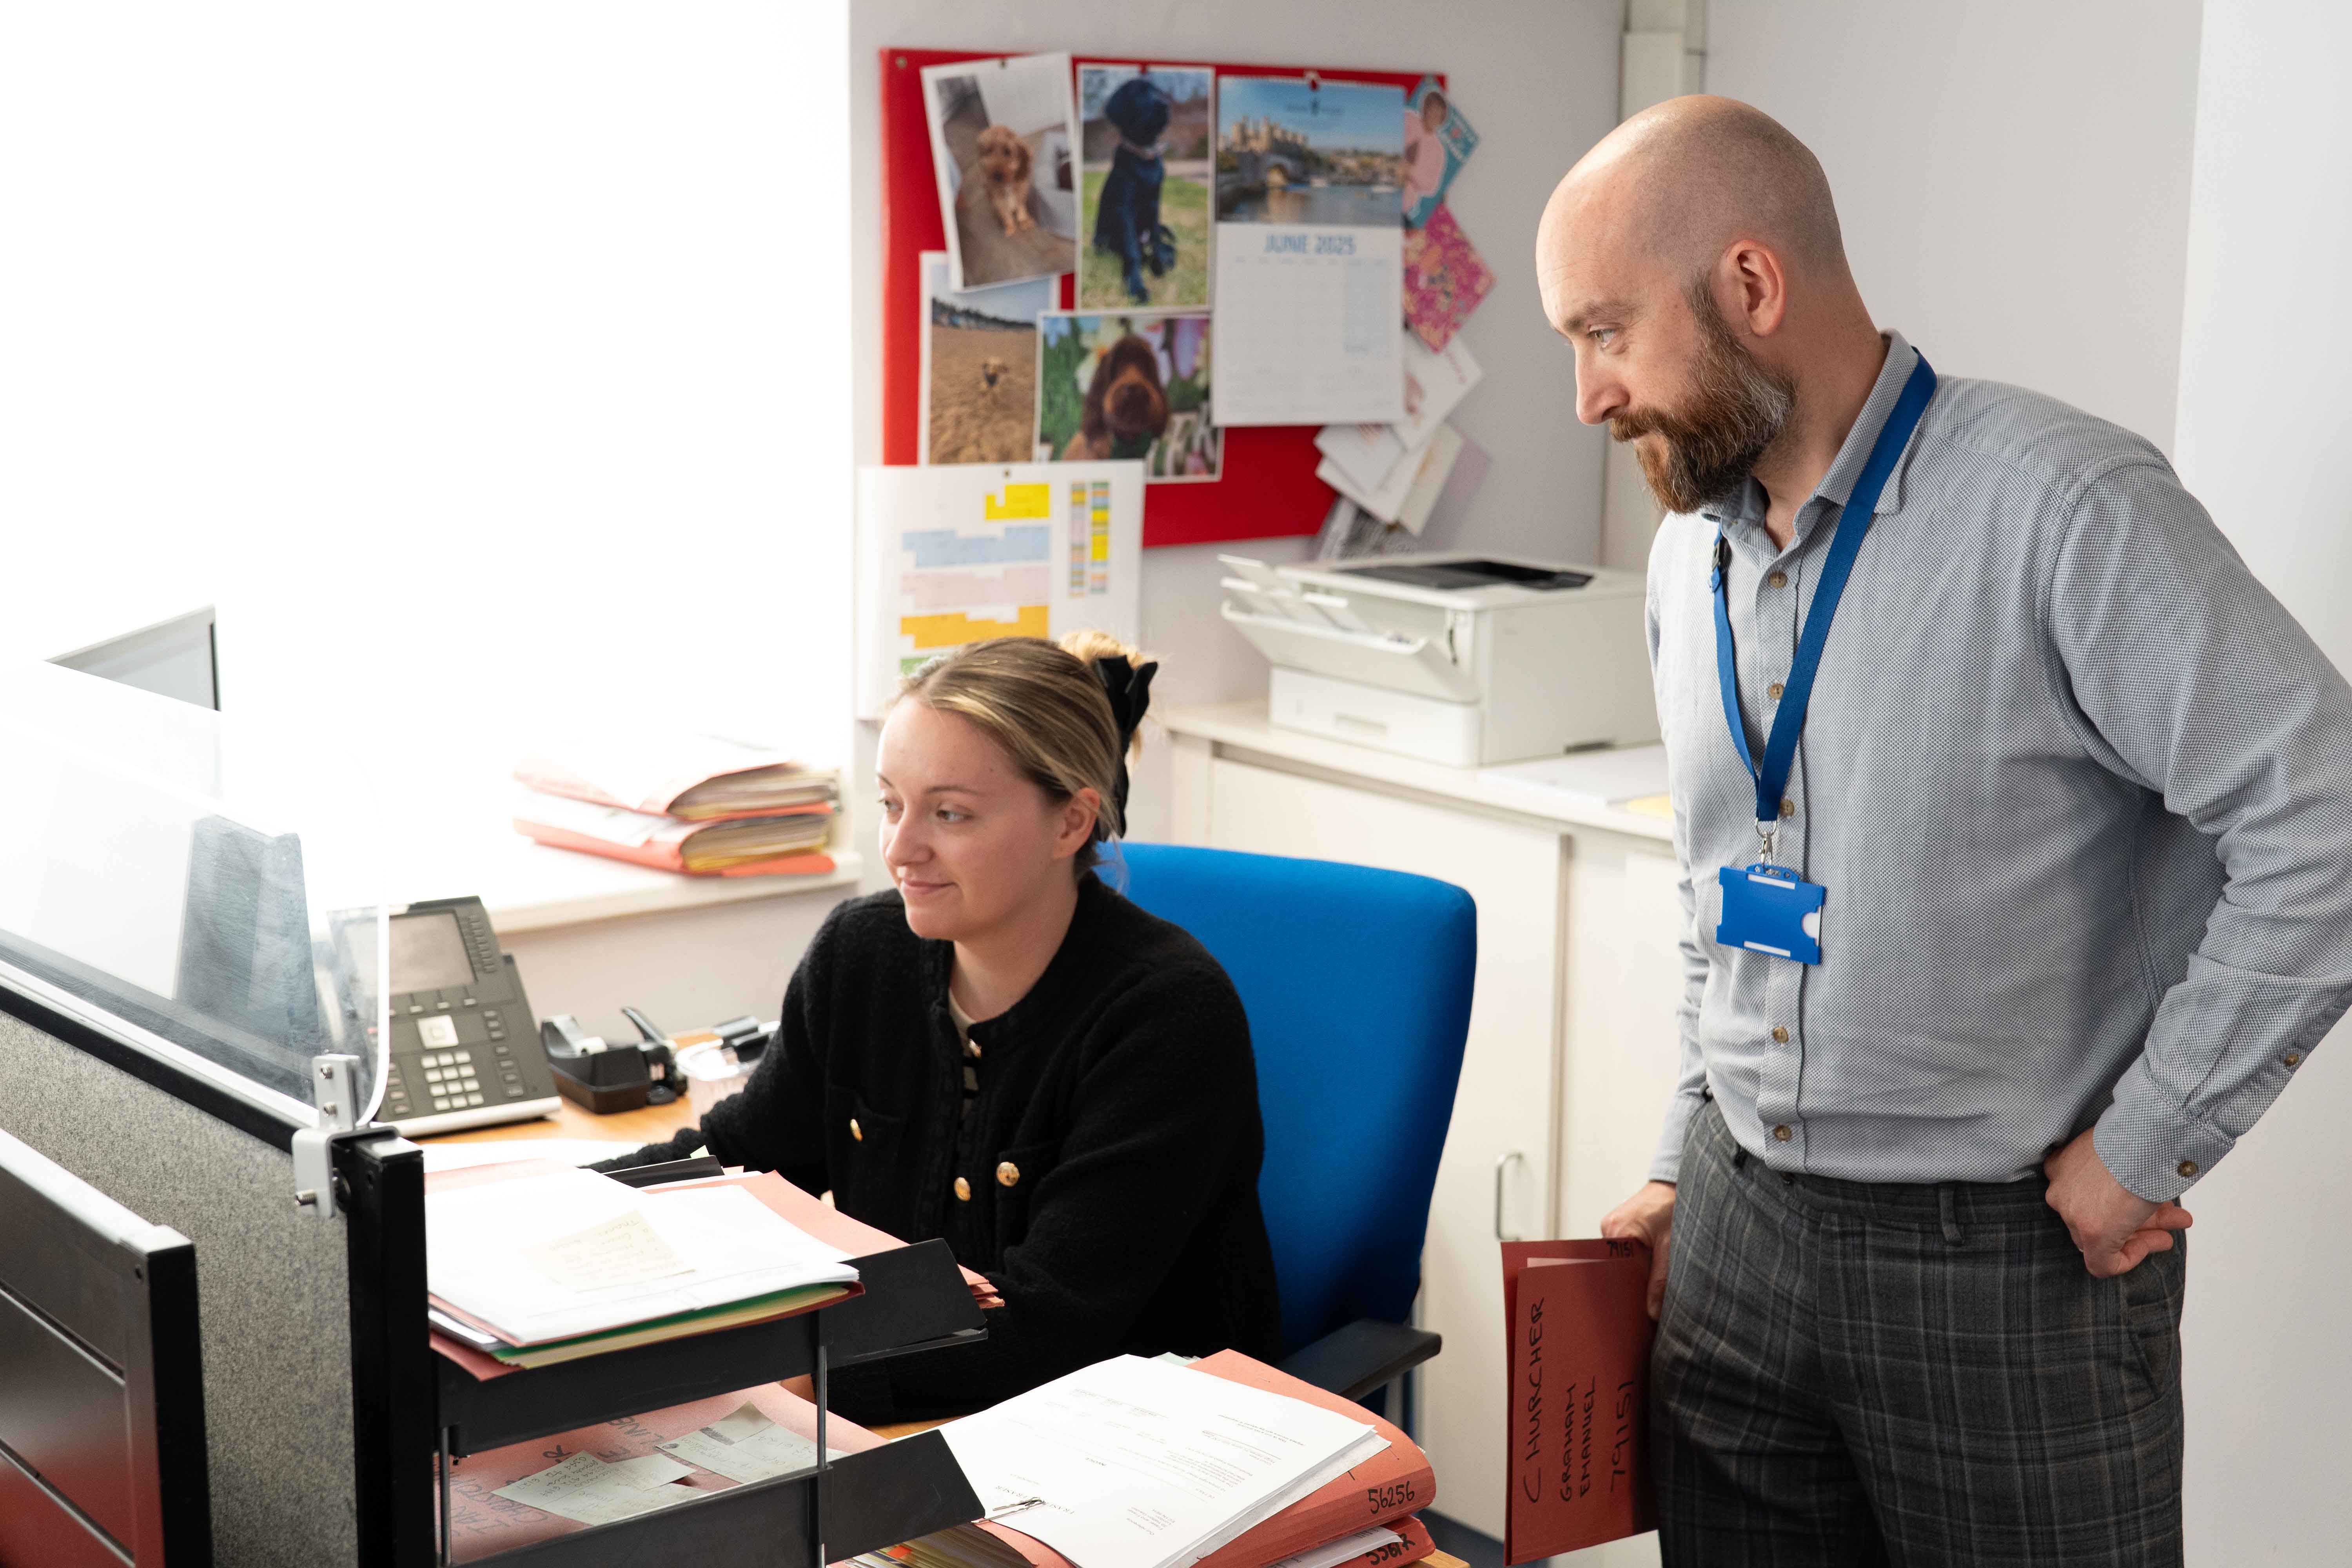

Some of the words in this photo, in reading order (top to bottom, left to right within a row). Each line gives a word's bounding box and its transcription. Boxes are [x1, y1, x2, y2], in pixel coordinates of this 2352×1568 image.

[1265, 234, 1308, 254] JUNE
[1315, 234, 1356, 256] 2025
[1523, 1297, 1544, 1503] CHURCHER
[1560, 1382, 1577, 1501] GRAHAM
[1580, 1375, 1595, 1498] EMANUEL
[1610, 1381, 1635, 1493] 79151
[1367, 1481, 1415, 1514] 56256
